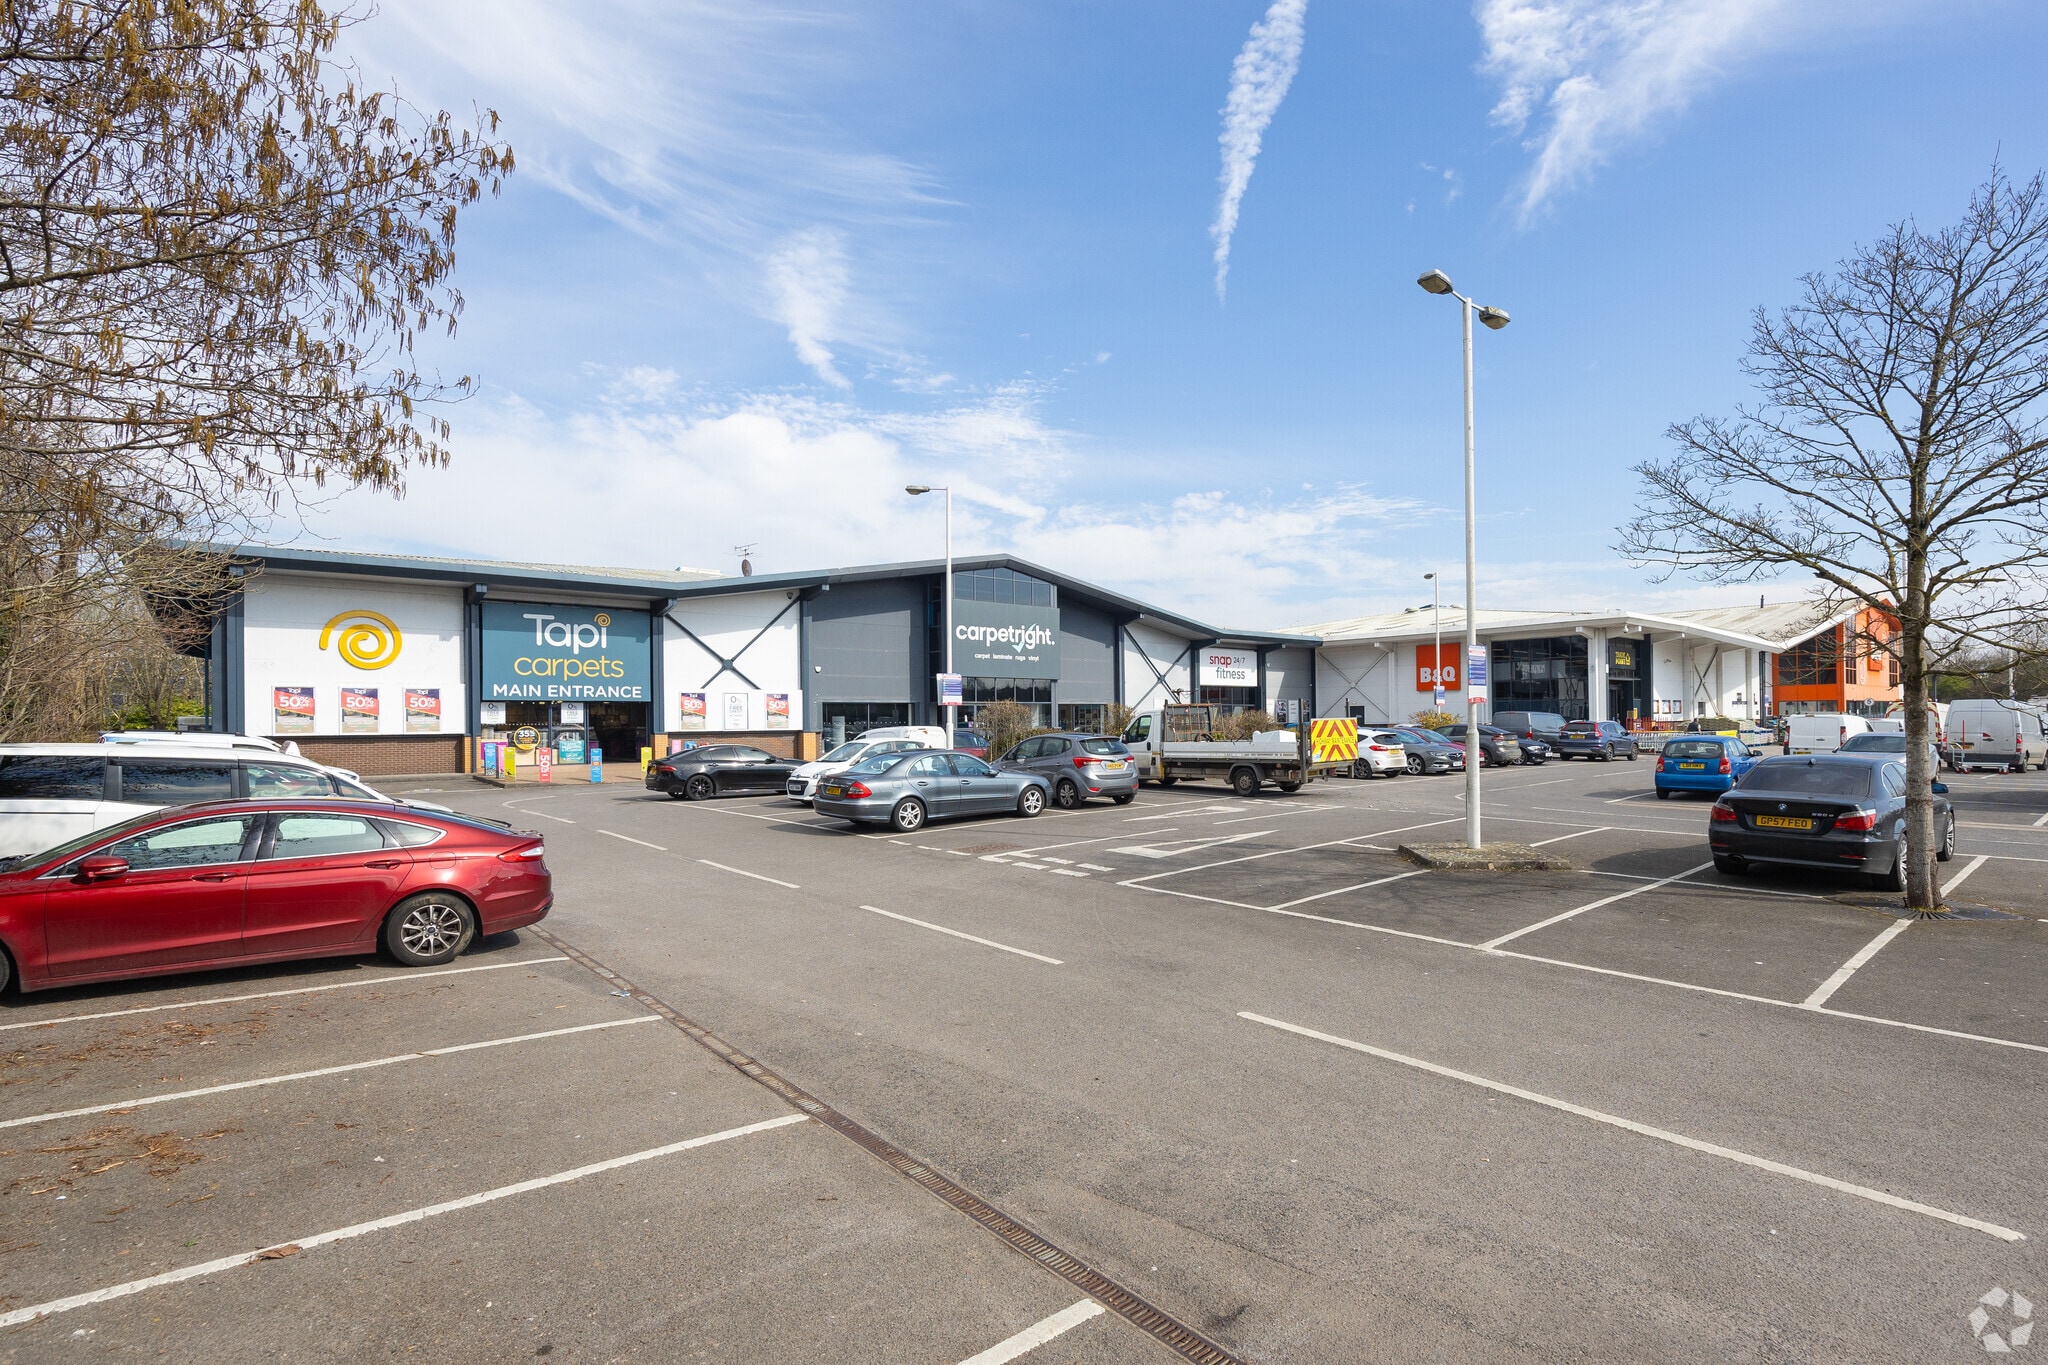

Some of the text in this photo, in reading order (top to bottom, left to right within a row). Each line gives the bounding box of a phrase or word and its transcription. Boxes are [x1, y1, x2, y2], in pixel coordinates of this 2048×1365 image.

[523, 613, 611, 655] Tapi
[1028, 655, 1040, 663] vinyl
[1209, 655, 1246, 668] snap 24/7
[513, 655, 625, 682] carpets
[1216, 667, 1246, 680] fitness
[493, 683, 642, 699] MAIN ENTRANCE
[279, 695, 310, 708] 50%
[345, 696, 375, 708] 50%
[409, 697, 437, 708] 50%
[1760, 816, 1785, 827] GP57
